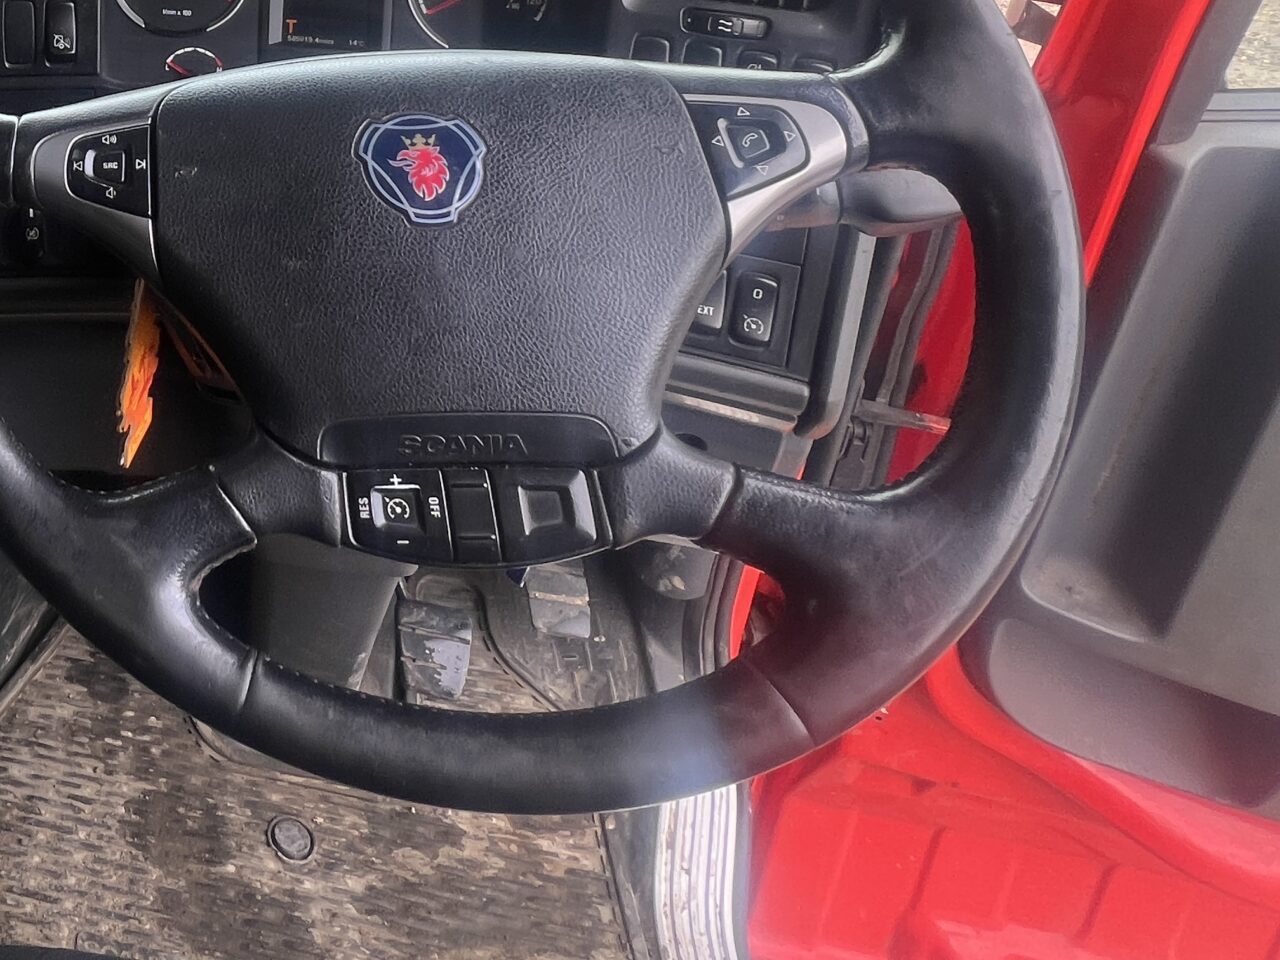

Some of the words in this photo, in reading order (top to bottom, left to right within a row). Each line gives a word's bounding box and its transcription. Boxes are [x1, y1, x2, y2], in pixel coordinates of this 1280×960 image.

[103, 161, 118, 169] SRC
[398, 433, 529, 456] SCANIA
[358, 496, 370, 519] RES
[428, 496, 441, 518] OFF
